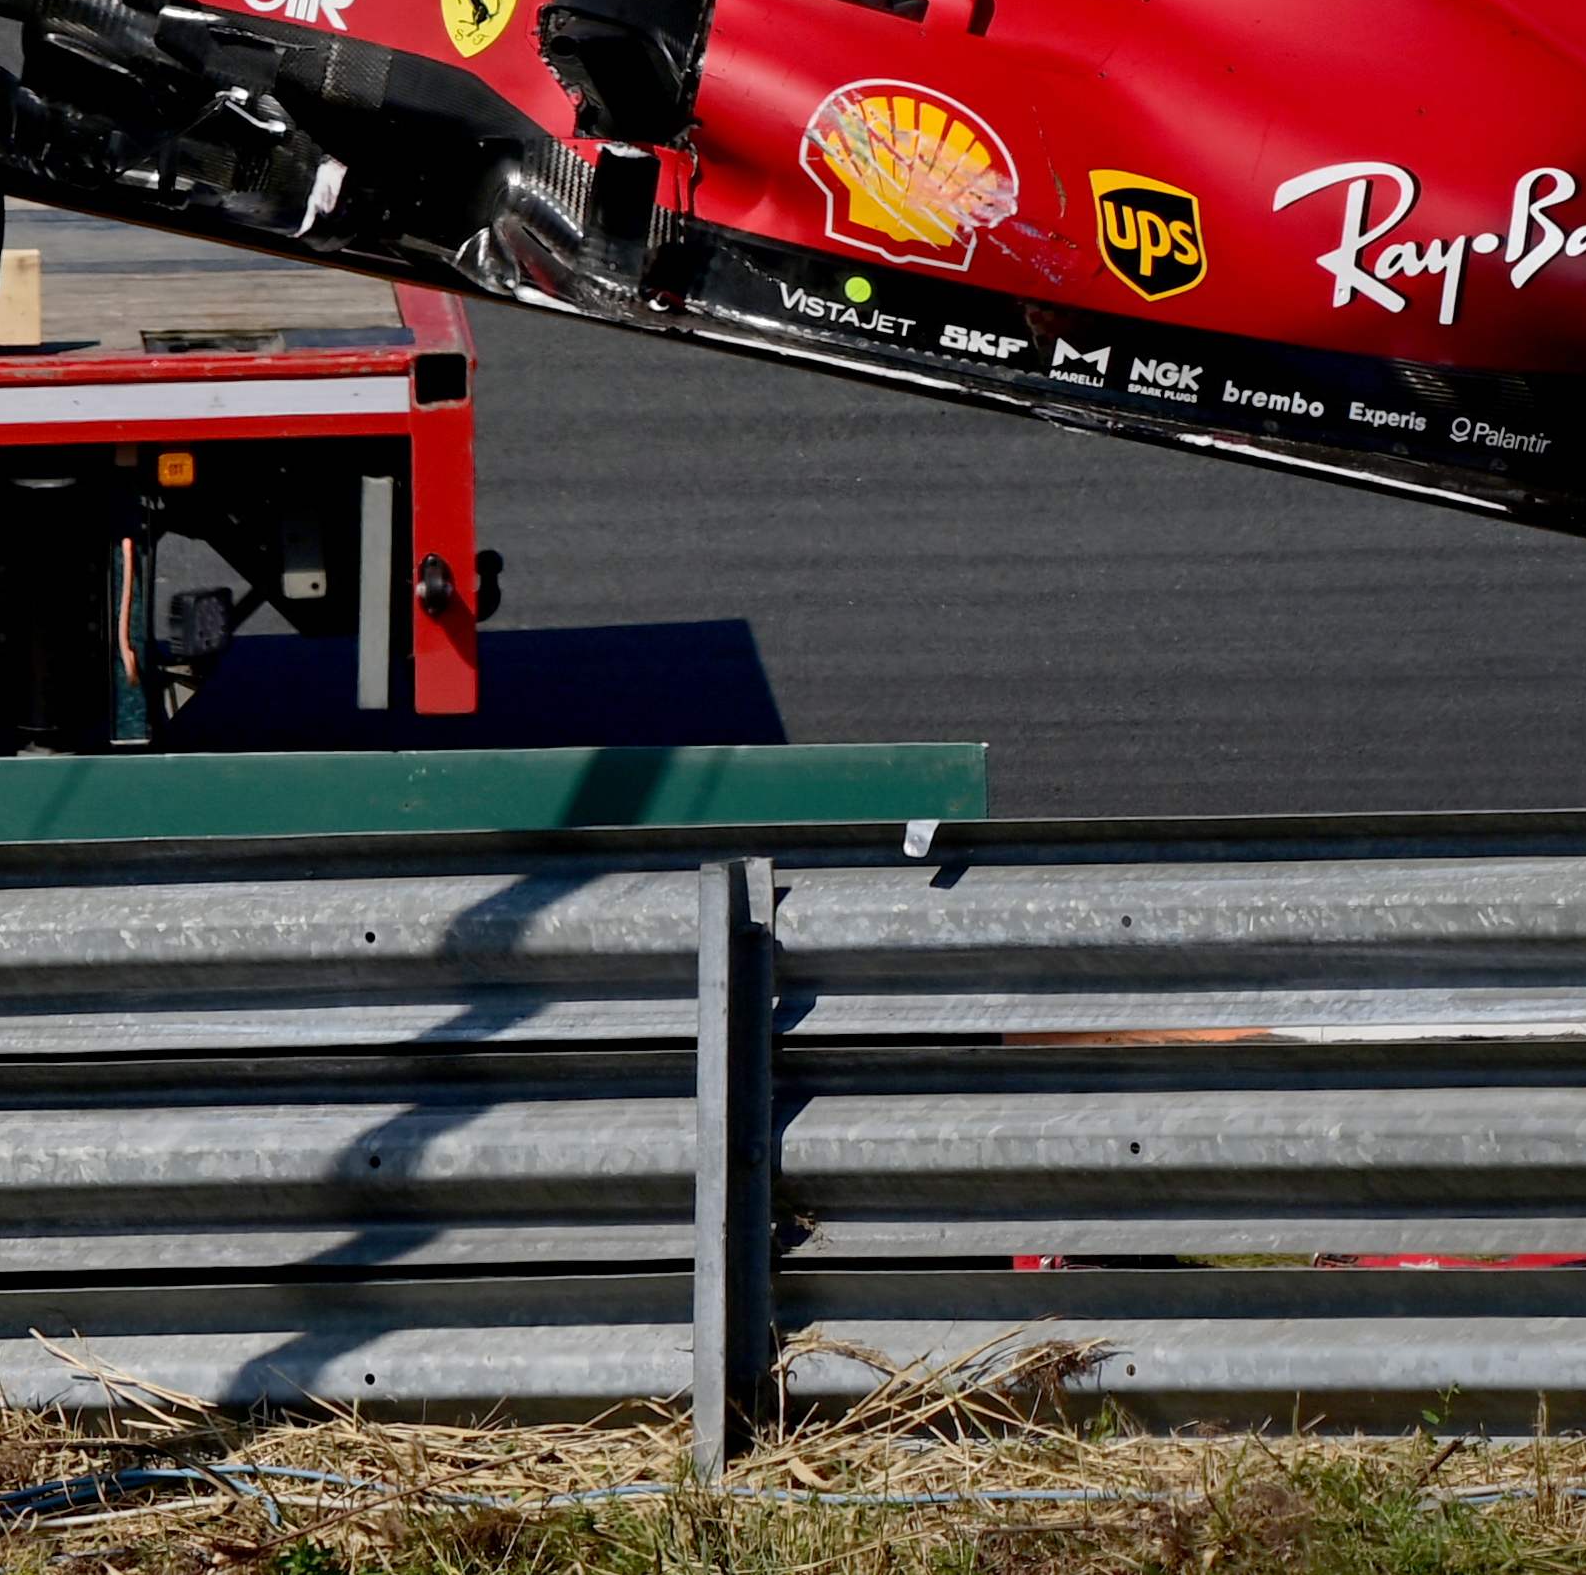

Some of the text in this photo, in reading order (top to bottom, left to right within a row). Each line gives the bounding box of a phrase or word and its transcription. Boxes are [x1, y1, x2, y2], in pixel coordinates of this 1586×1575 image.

[939, 324, 1029, 359] SKF
[1049, 368, 1105, 388] MARELLI
[1129, 356, 1204, 392] NGK
[1127, 383, 1199, 404] SPARK PLUGS
[1221, 379, 1325, 418] brembo
[1348, 401, 1428, 432] Experis
[1471, 421, 1552, 455] Palantir
